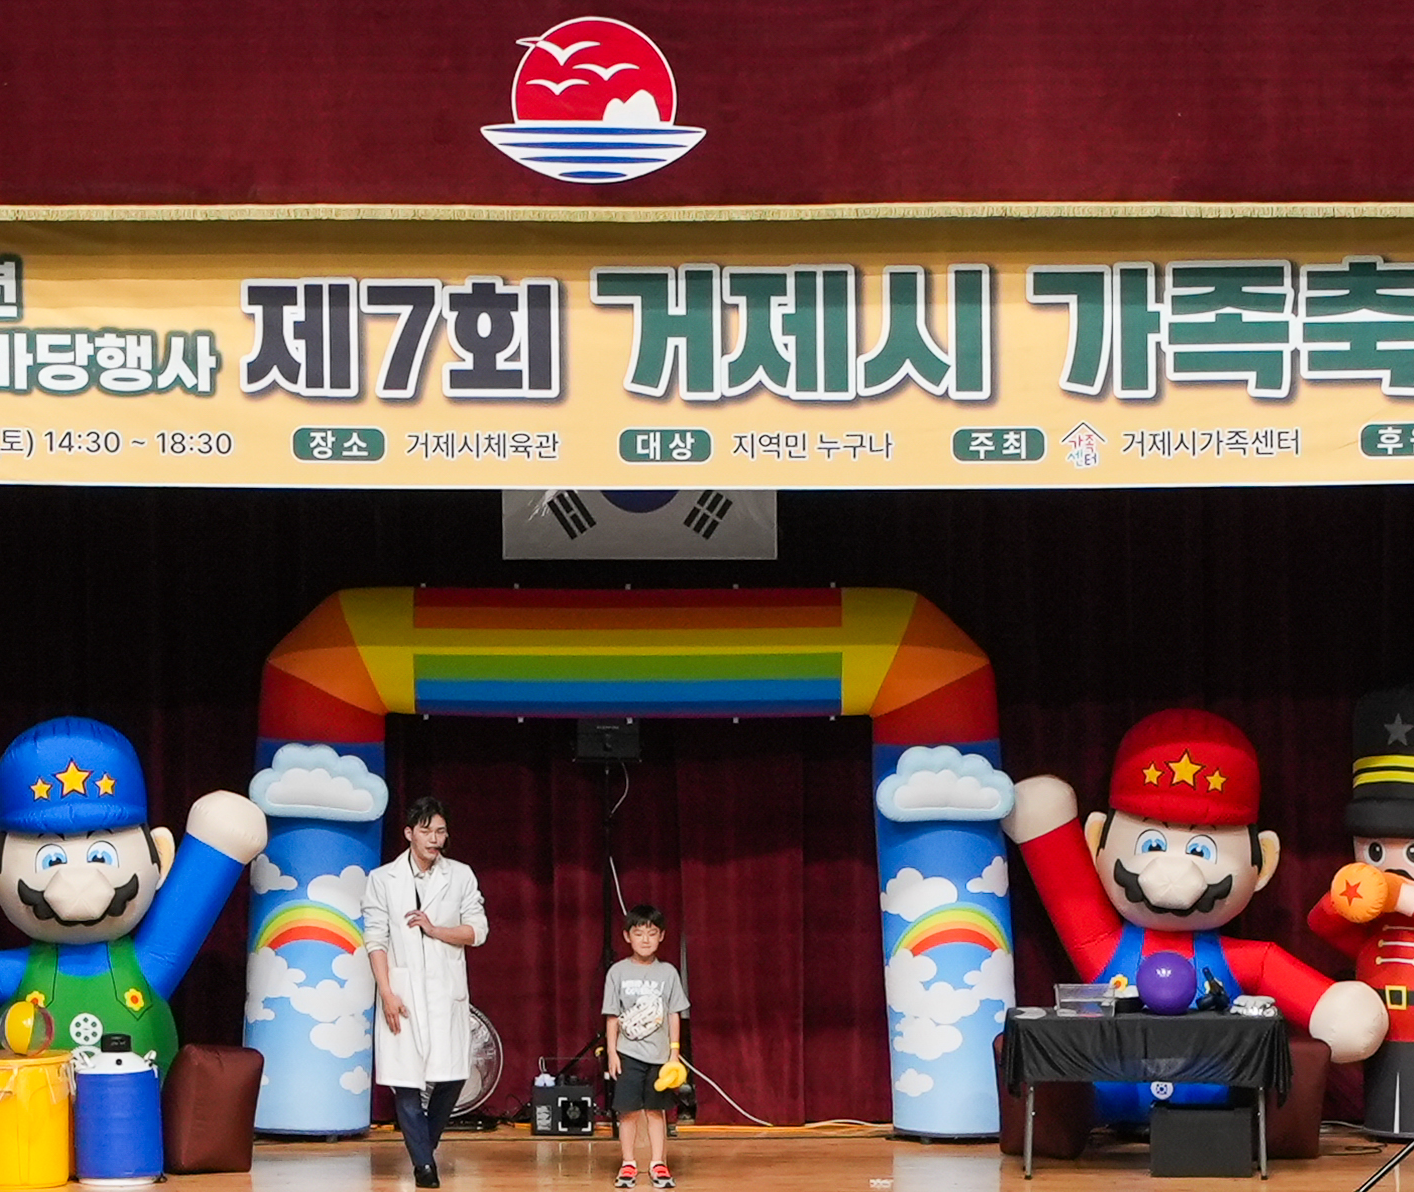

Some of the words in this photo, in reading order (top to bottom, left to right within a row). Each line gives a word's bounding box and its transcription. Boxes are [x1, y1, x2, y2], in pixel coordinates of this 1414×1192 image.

[244, 280, 561, 397] 제7회
[591, 264, 995, 401] 거제시
[44, 431, 120, 453] 14:30
[157, 432, 233, 455] 18:30
[405, 432, 560, 461] 거제시체육관
[733, 432, 808, 459] 지역민
[818, 432, 894, 460] 누구나
[1071, 433, 1096, 451] 가족
[1122, 428, 1301, 457] 거제시가족센터
[1067, 450, 1098, 467] 센터
